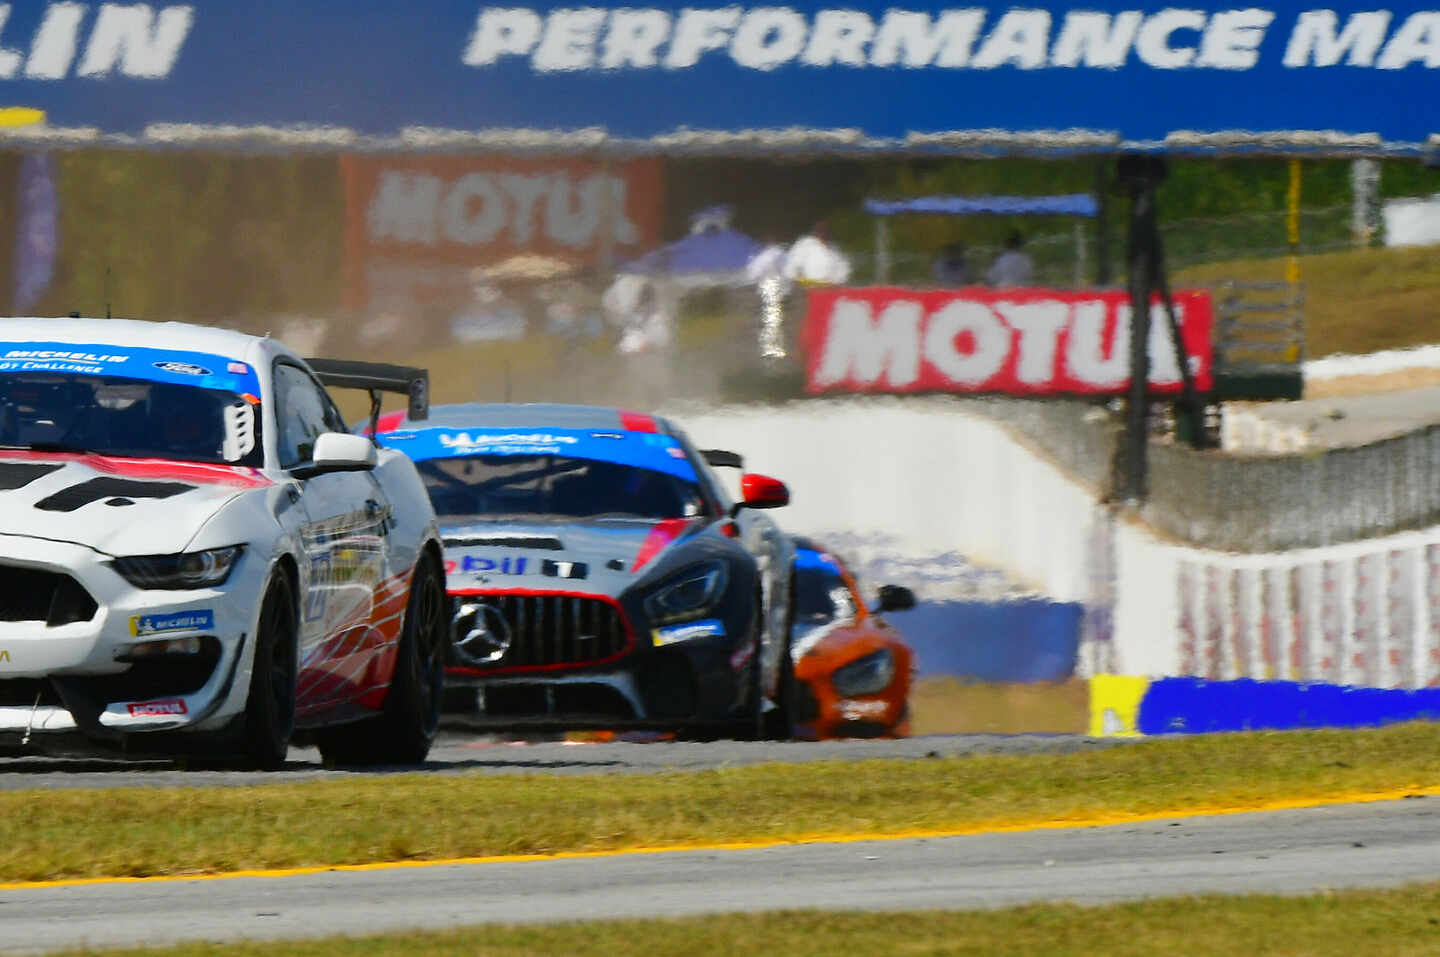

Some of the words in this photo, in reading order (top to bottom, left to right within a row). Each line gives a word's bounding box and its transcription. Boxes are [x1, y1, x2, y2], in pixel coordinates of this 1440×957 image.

[464, 7, 1274, 75] PERFORMANCE
[5, 350, 130, 363] MICHELIN
[157, 617, 209, 629] MICHELIN
